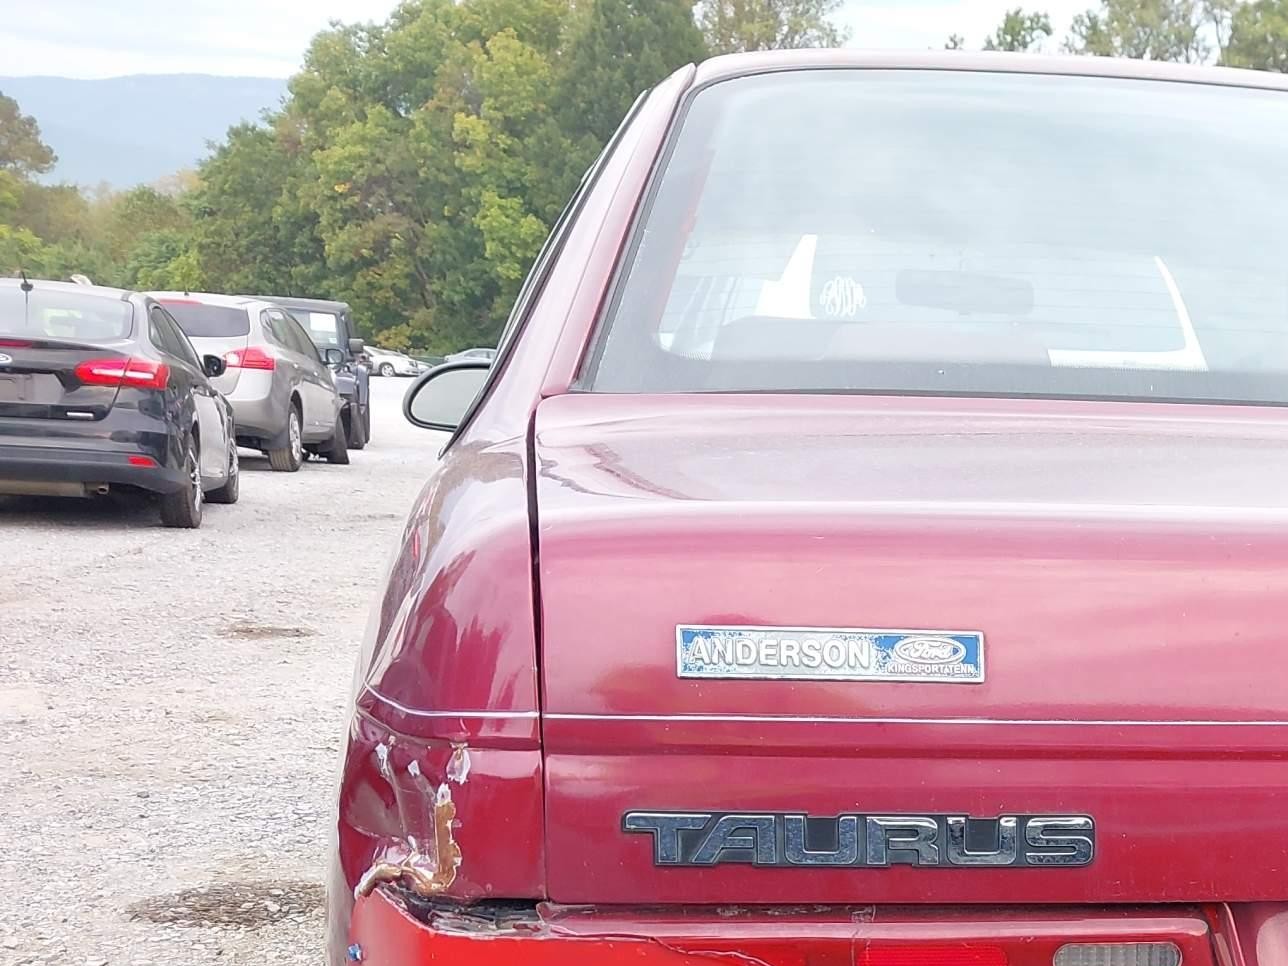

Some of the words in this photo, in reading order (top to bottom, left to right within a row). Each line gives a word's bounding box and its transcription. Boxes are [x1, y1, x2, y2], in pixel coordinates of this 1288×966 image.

[690, 637, 871, 668] ANDERSON
[908, 640, 951, 660] Ford
[887, 663, 945, 674] KINGSPORT
[624, 813, 1095, 866] TAURUS
